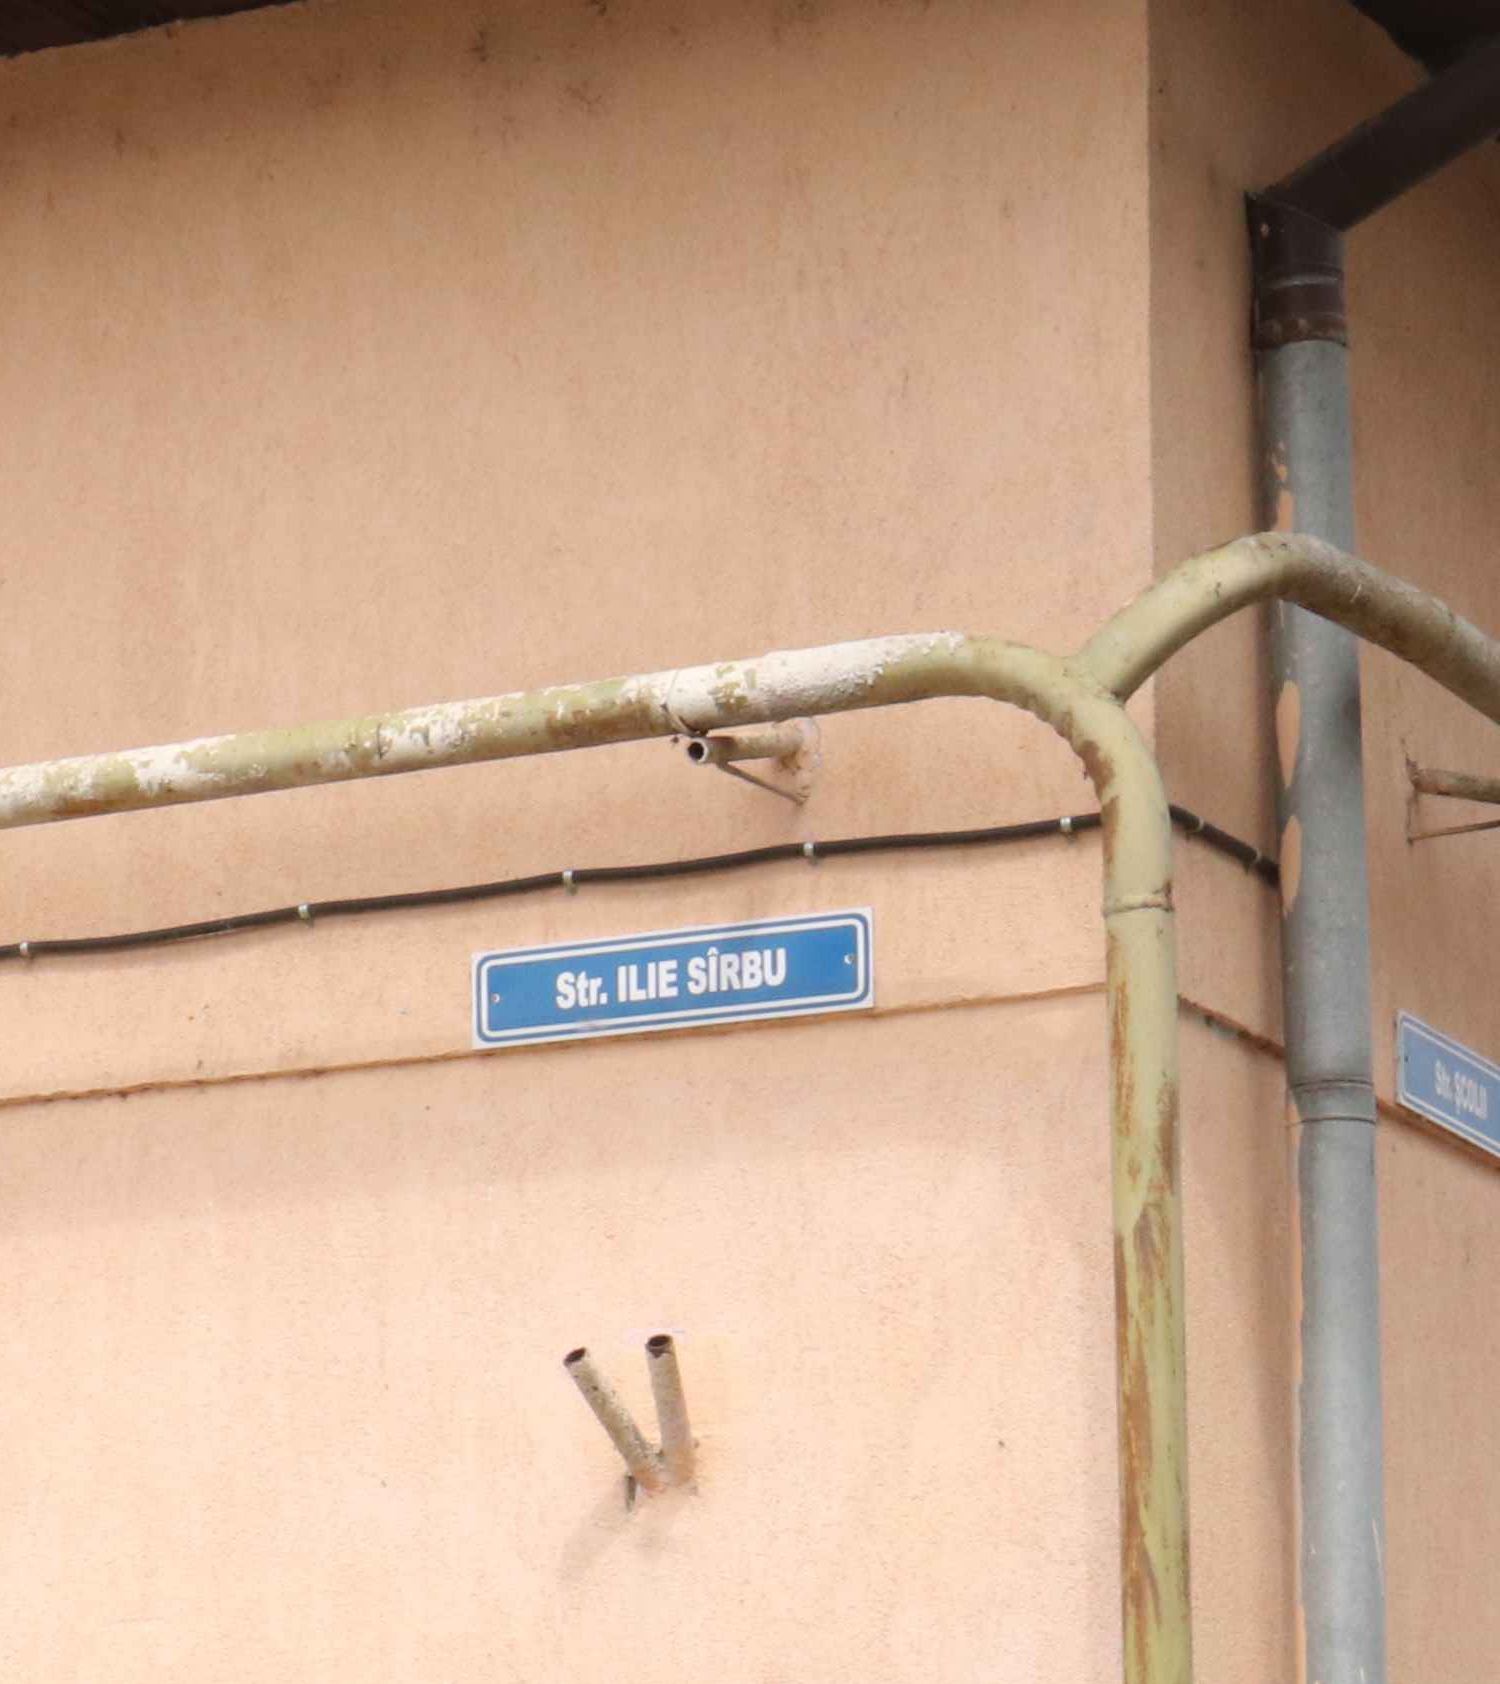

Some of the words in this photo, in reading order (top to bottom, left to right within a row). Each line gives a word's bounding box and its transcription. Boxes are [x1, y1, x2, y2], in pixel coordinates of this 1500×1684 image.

[555, 971, 608, 1010] Str.
[617, 960, 678, 1002] ILIE
[687, 947, 787, 994] SÎRBU
